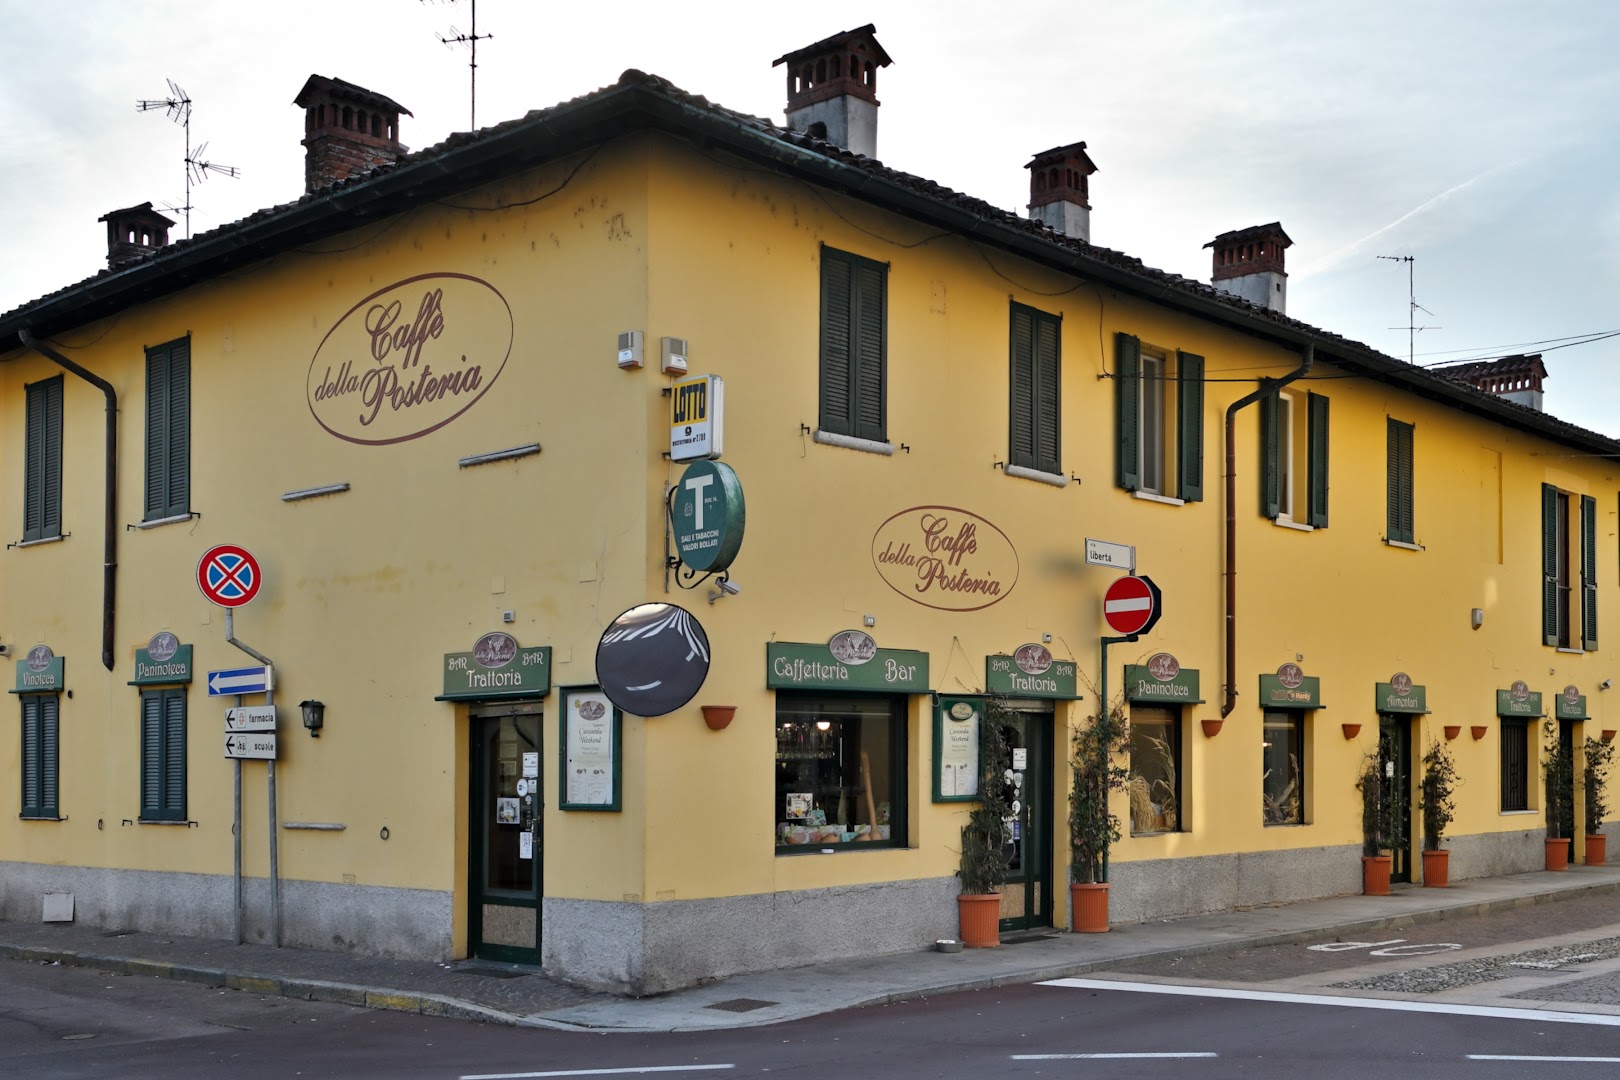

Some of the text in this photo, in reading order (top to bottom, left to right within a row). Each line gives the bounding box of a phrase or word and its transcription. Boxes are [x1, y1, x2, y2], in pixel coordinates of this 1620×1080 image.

[315, 354, 484, 426] della Posteria
[673, 382, 706, 424] LOTTO
[685, 473, 714, 531] T
[695, 529, 719, 541] TABACCHI
[682, 539, 718, 552] VALORI BOLLATI
[878, 541, 1001, 596] della Posteria
[448, 656, 468, 671] BAR
[522, 651, 544, 666] BAR
[992, 660, 1010, 673] BAR
[138, 662, 186, 680] Paninoteca
[774, 656, 848, 682] Caffetteria
[885, 658, 916, 682] Bar
[1056, 665, 1073, 677] BAR
[23, 672, 55, 687] Vinoteca
[466, 669, 522, 688] Trattoria
[1009, 672, 1057, 693] Trattoria
[1138, 679, 1189, 697] Paninoteca
[249, 713, 274, 723] farmacia
[254, 741, 274, 751] scuole
